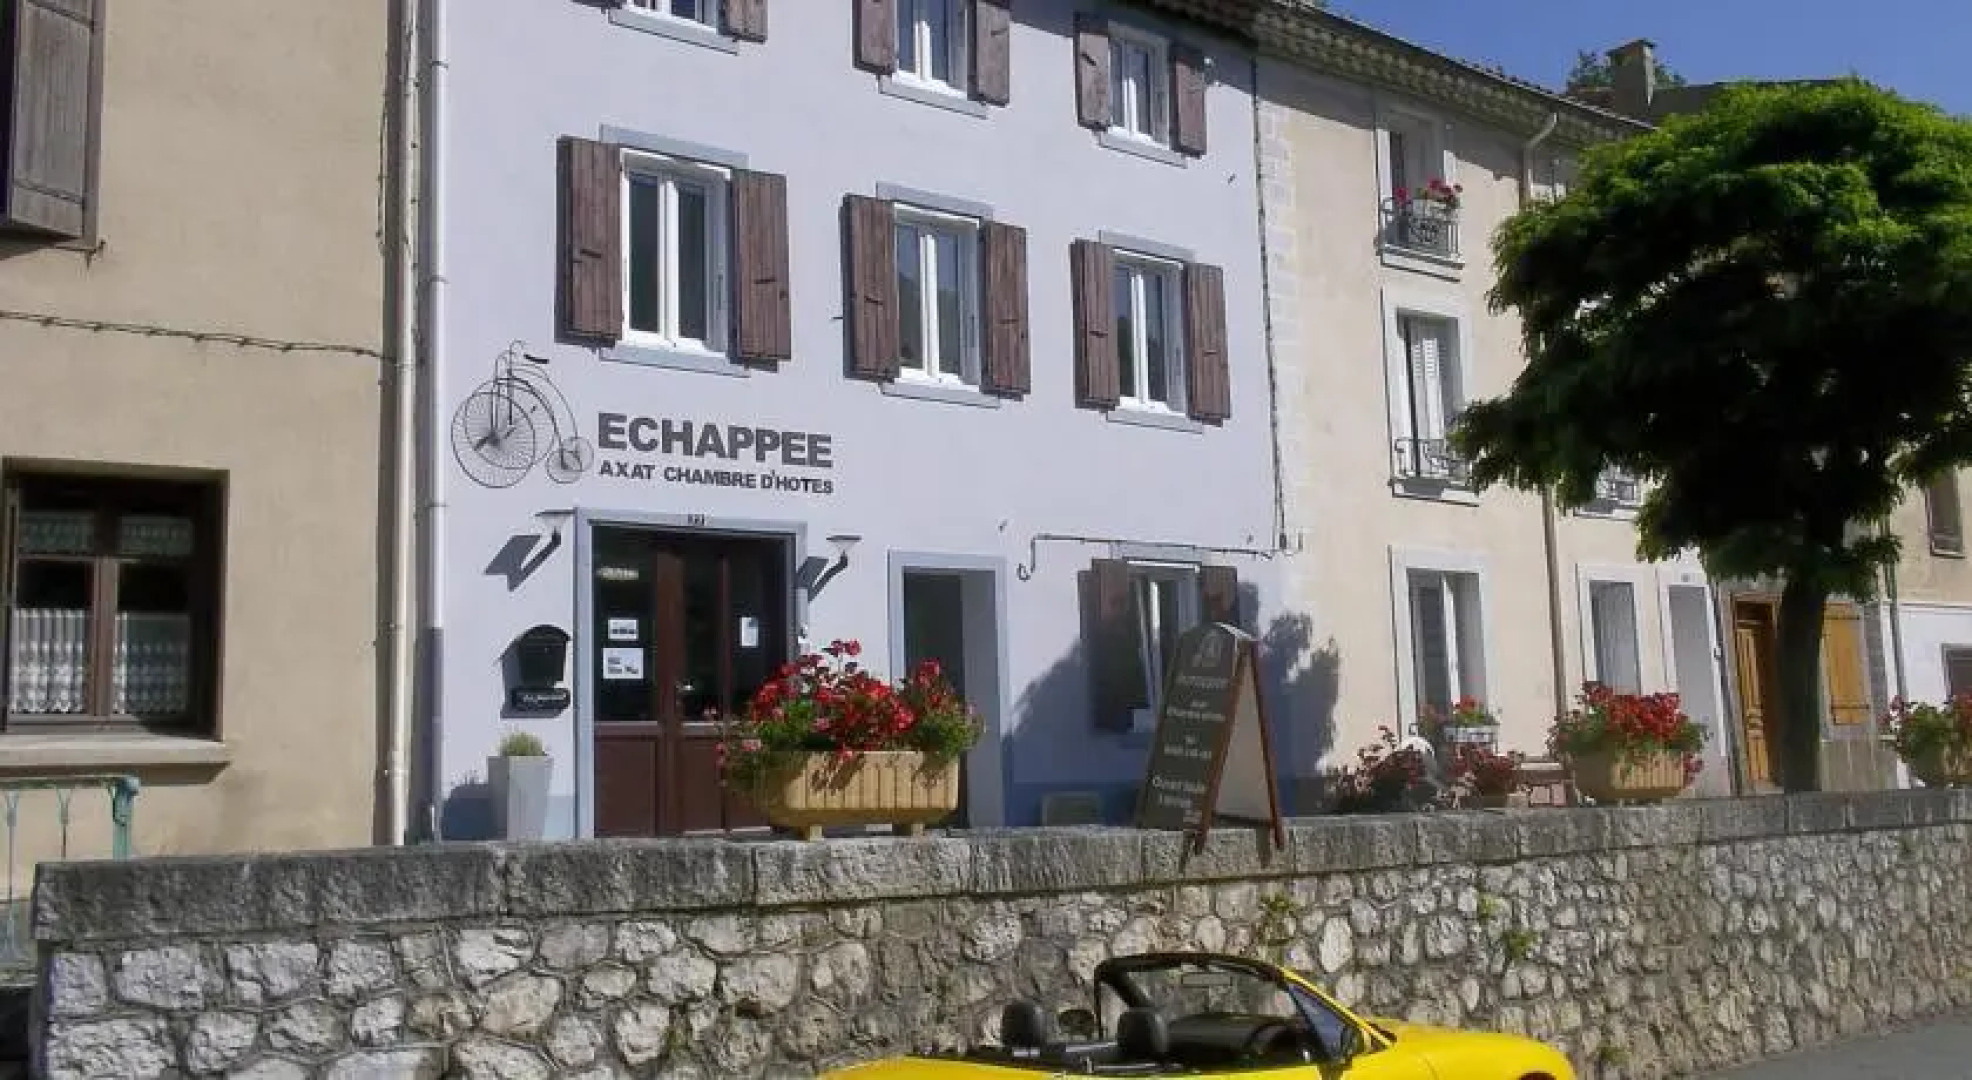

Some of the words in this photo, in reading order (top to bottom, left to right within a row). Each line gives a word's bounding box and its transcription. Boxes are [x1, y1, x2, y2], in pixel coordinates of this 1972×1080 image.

[598, 413, 832, 468] ECHAPPEE
[600, 460, 655, 480] AXAT
[663, 466, 756, 488] CHAMBRE
[761, 471, 833, 494] D'HOTES
